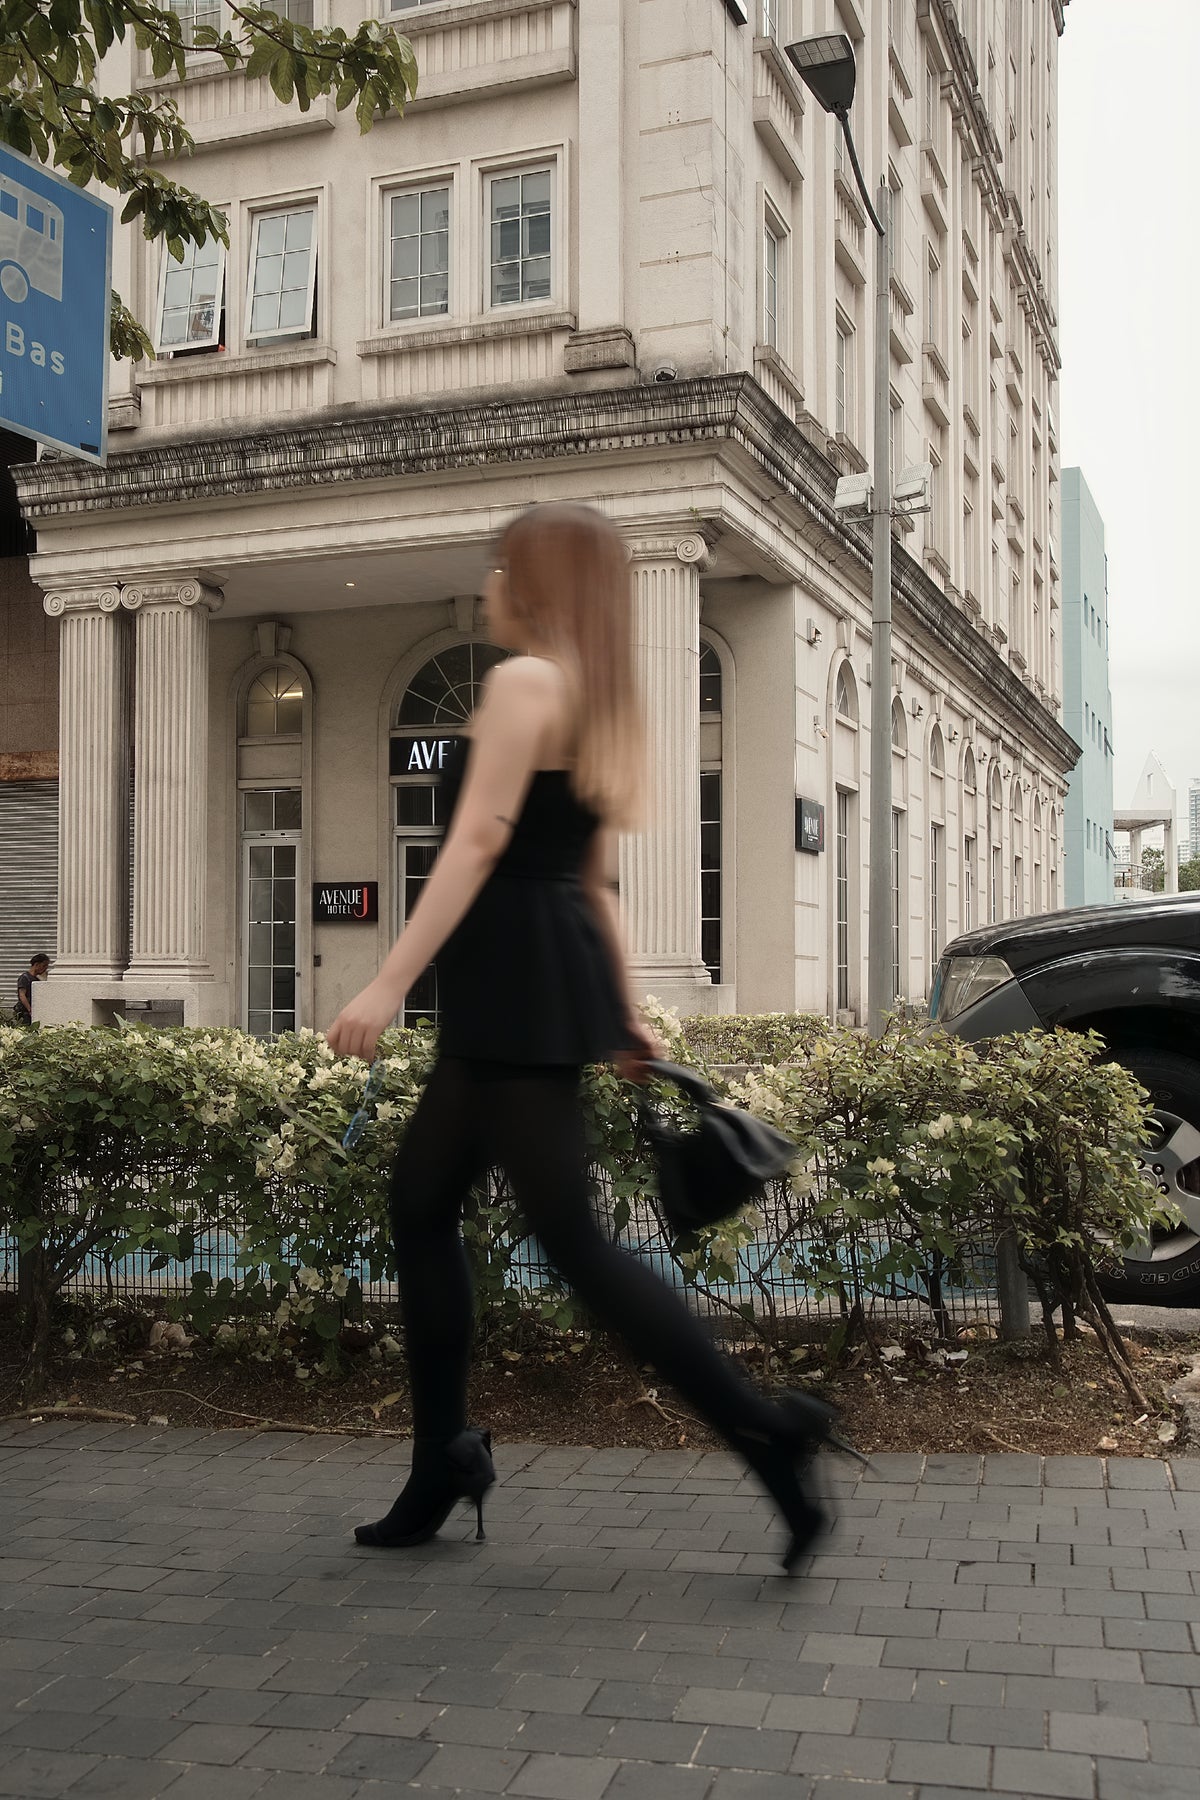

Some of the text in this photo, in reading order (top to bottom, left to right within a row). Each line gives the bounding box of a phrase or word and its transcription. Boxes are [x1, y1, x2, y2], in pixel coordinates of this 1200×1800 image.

[6, 321, 65, 375] Bas
[407, 740, 457, 770] AVE
[319, 889, 362, 905] AVENUE
[327, 904, 352, 915] HOTEL
